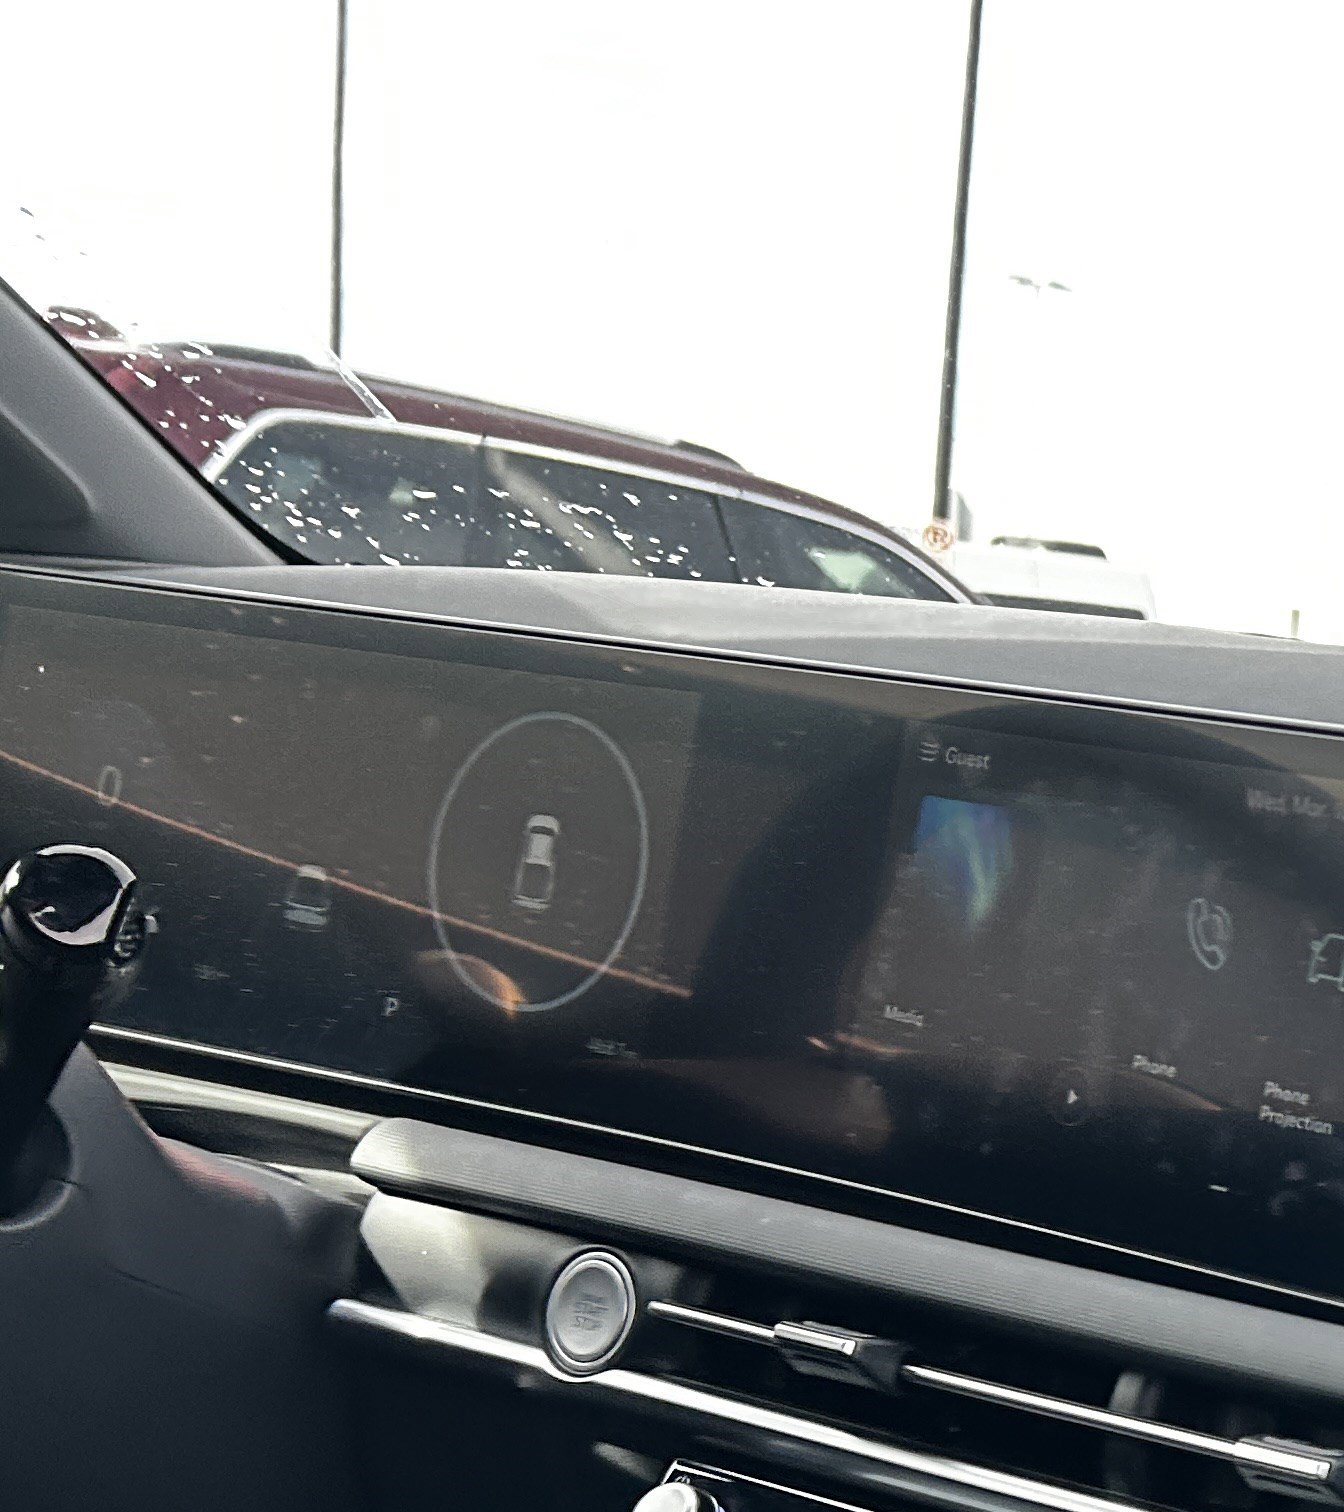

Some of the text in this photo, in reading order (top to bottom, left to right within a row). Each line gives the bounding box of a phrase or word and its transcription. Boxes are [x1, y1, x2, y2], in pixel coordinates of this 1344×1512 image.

[945, 746, 991, 770] Guest
[384, 996, 399, 1016] P
[1132, 1054, 1178, 1078] Phone
[1263, 1080, 1310, 1105] Phone
[1258, 1104, 1335, 1135] Projection
